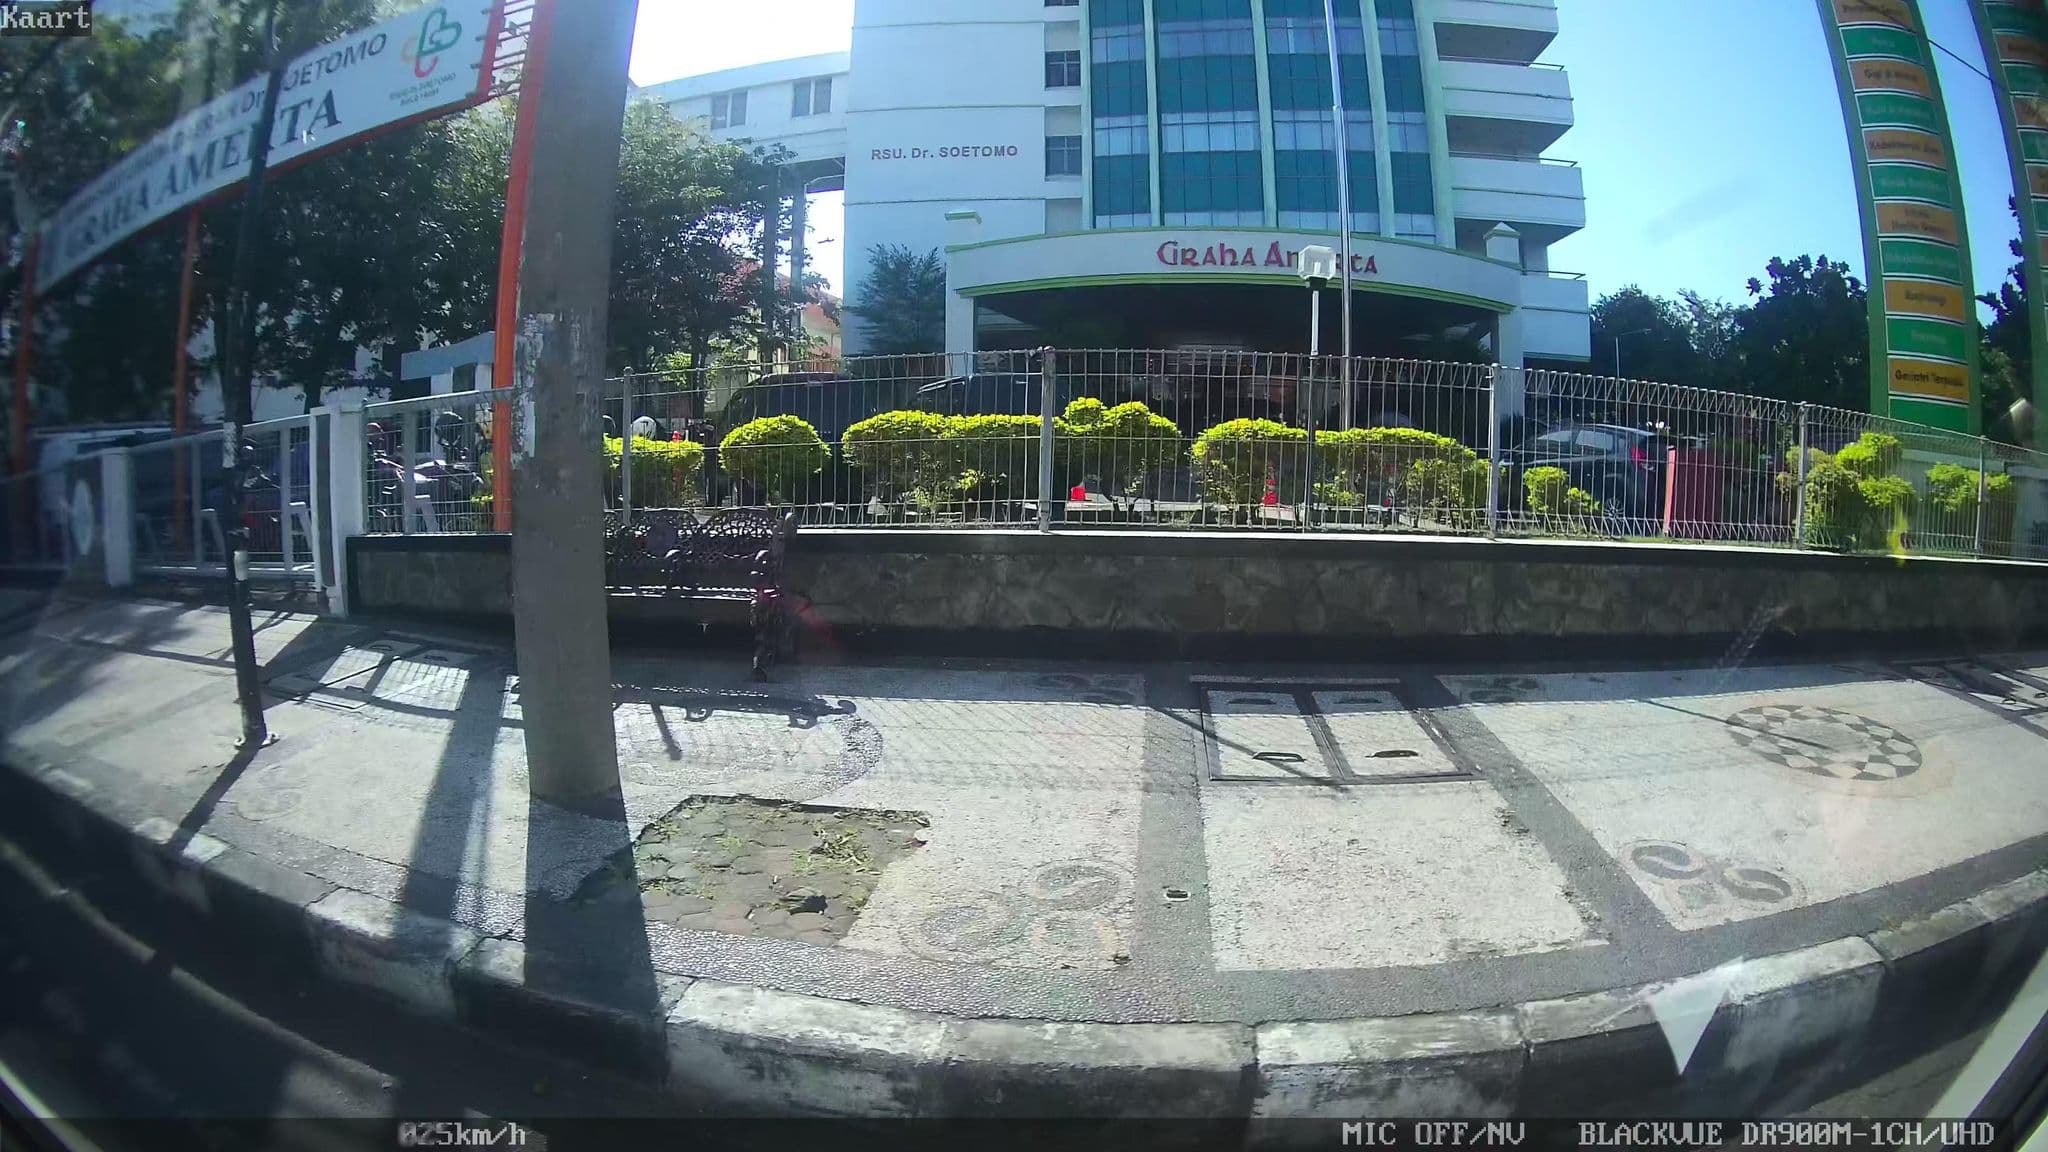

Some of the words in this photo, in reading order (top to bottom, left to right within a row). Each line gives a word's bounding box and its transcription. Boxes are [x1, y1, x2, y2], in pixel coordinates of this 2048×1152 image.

[281, 32, 388, 92] OETOMO
[871, 148, 907, 160] RSU.
[911, 147, 934, 159] Dr.
[939, 145, 1018, 158] SOETOMO
